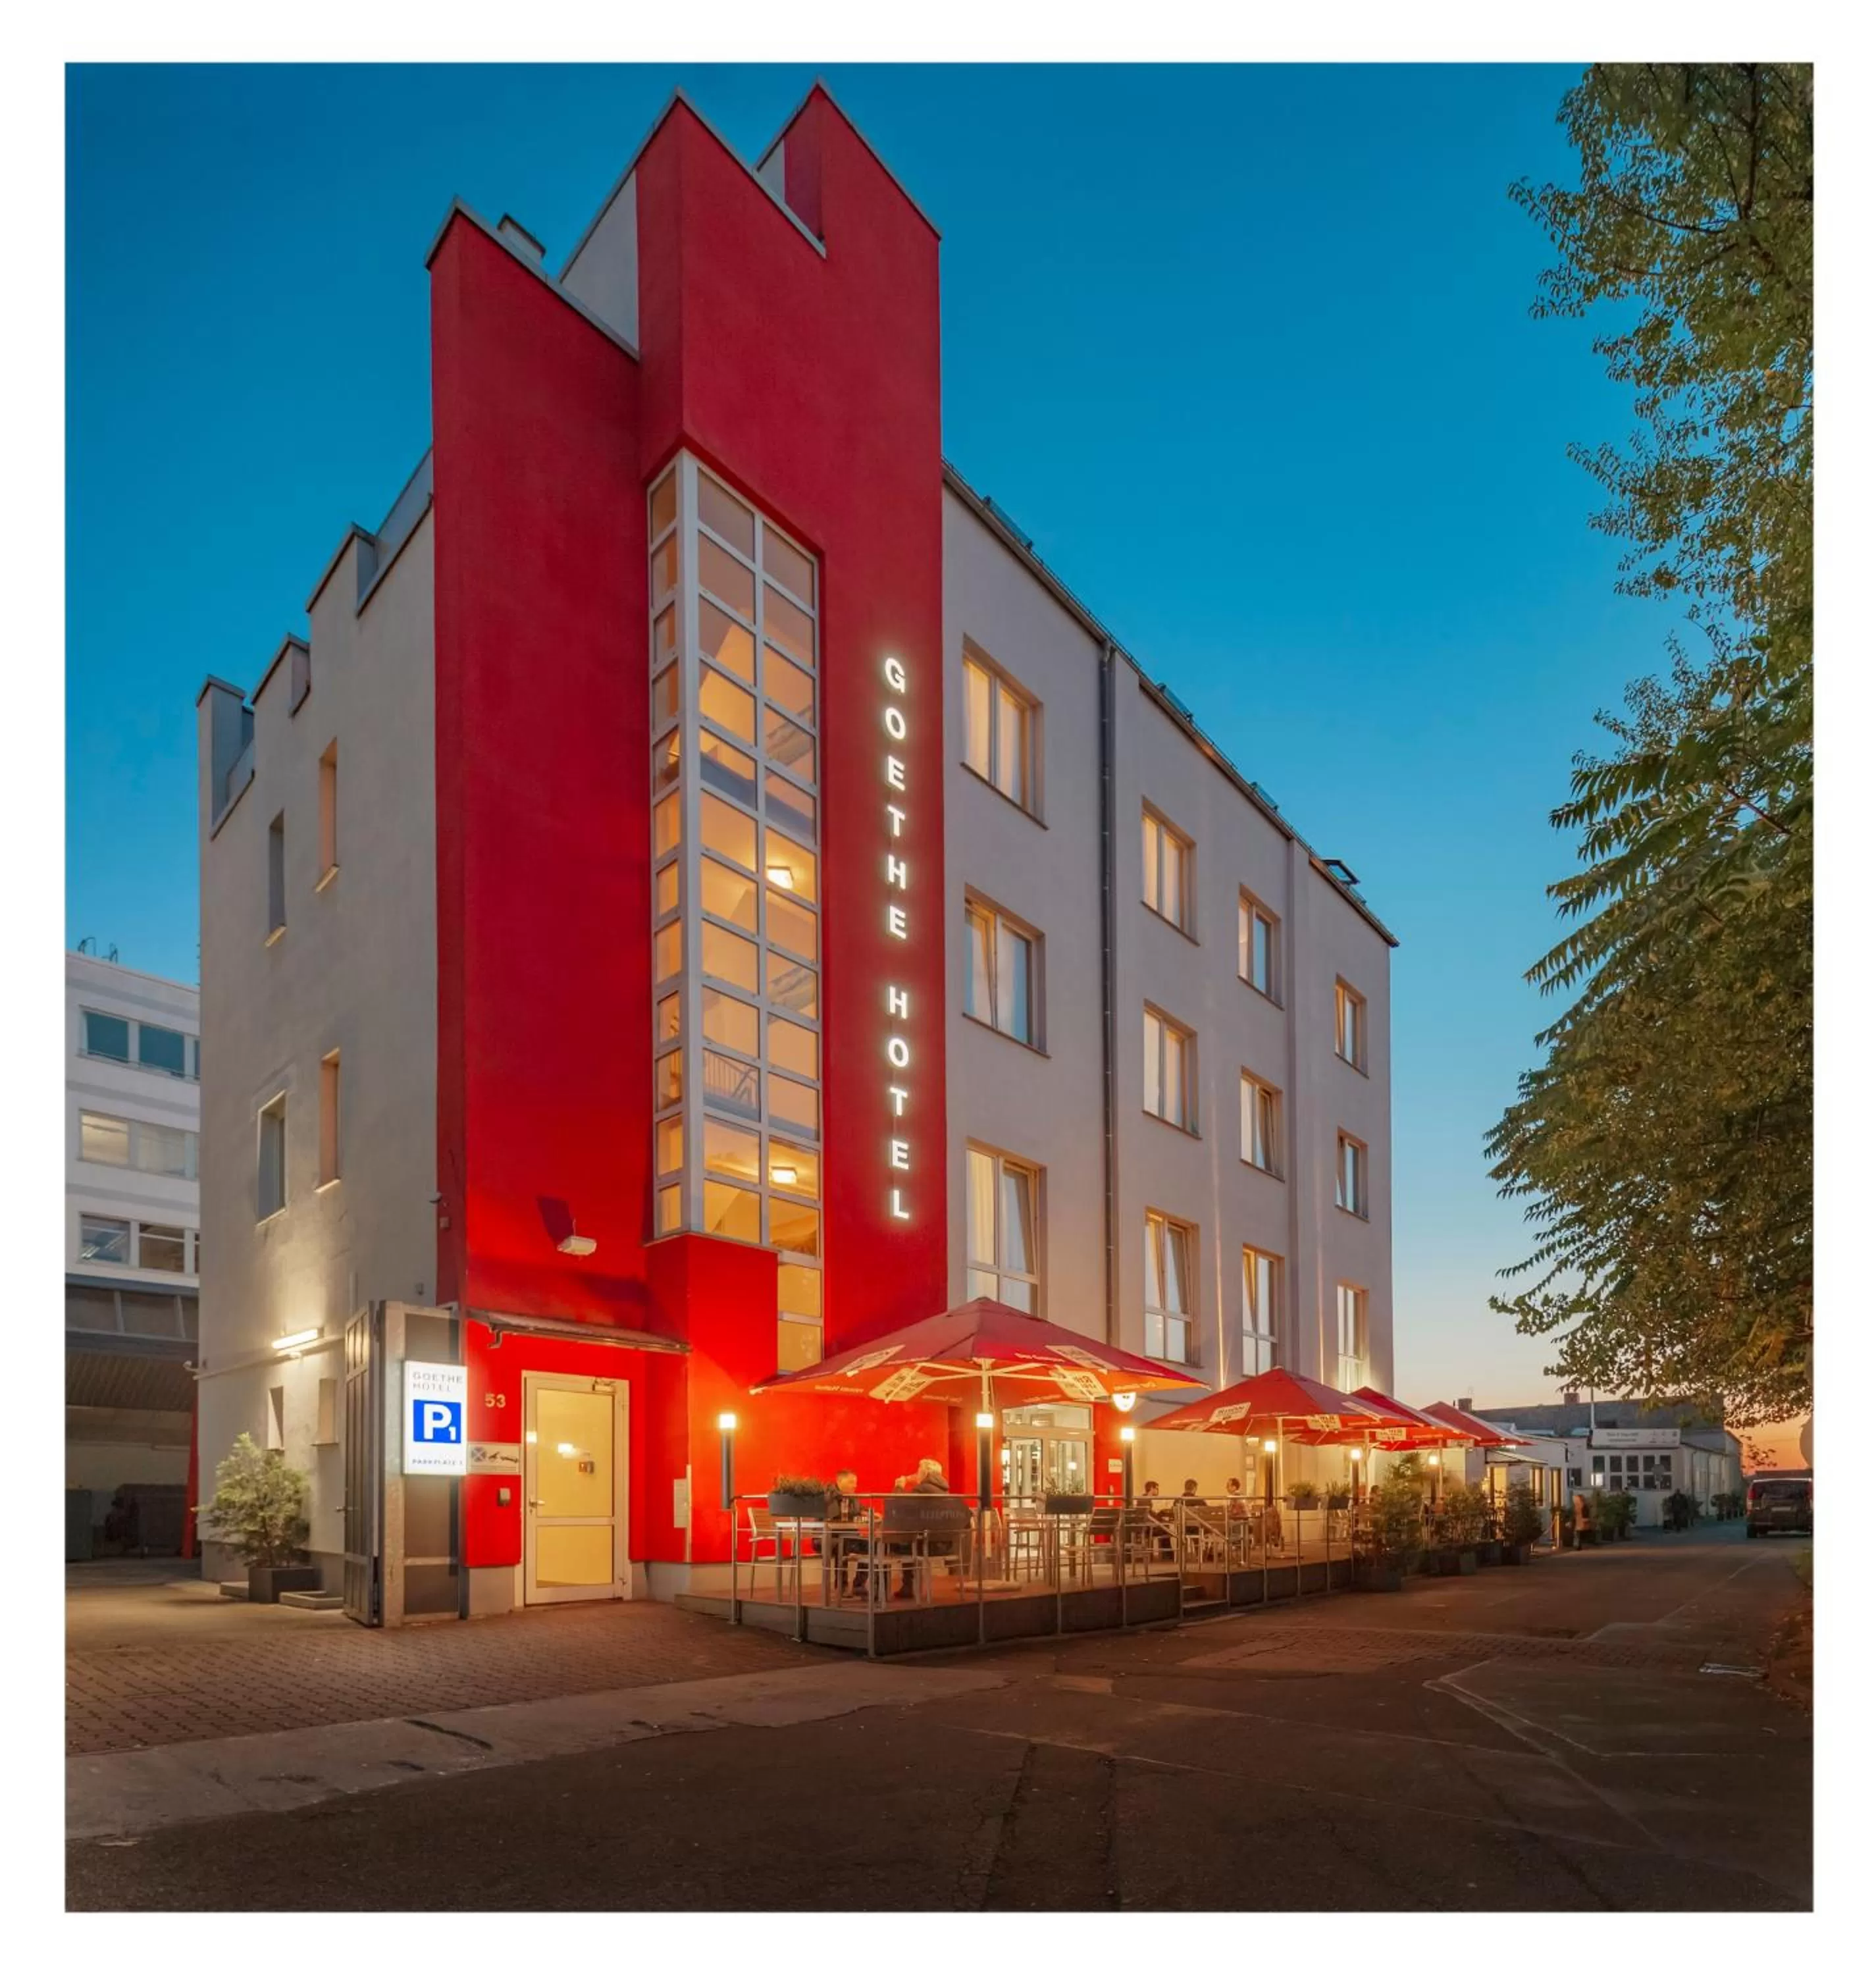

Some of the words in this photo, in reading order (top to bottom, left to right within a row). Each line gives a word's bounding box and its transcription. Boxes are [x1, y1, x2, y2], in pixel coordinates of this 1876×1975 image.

[884, 657, 906, 940] GOETHE
[887, 986, 910, 1220] HOTEL
[413, 1371, 463, 1384] GOETHE
[413, 1382, 451, 1392] HOTEL
[484, 1394, 506, 1408] 53
